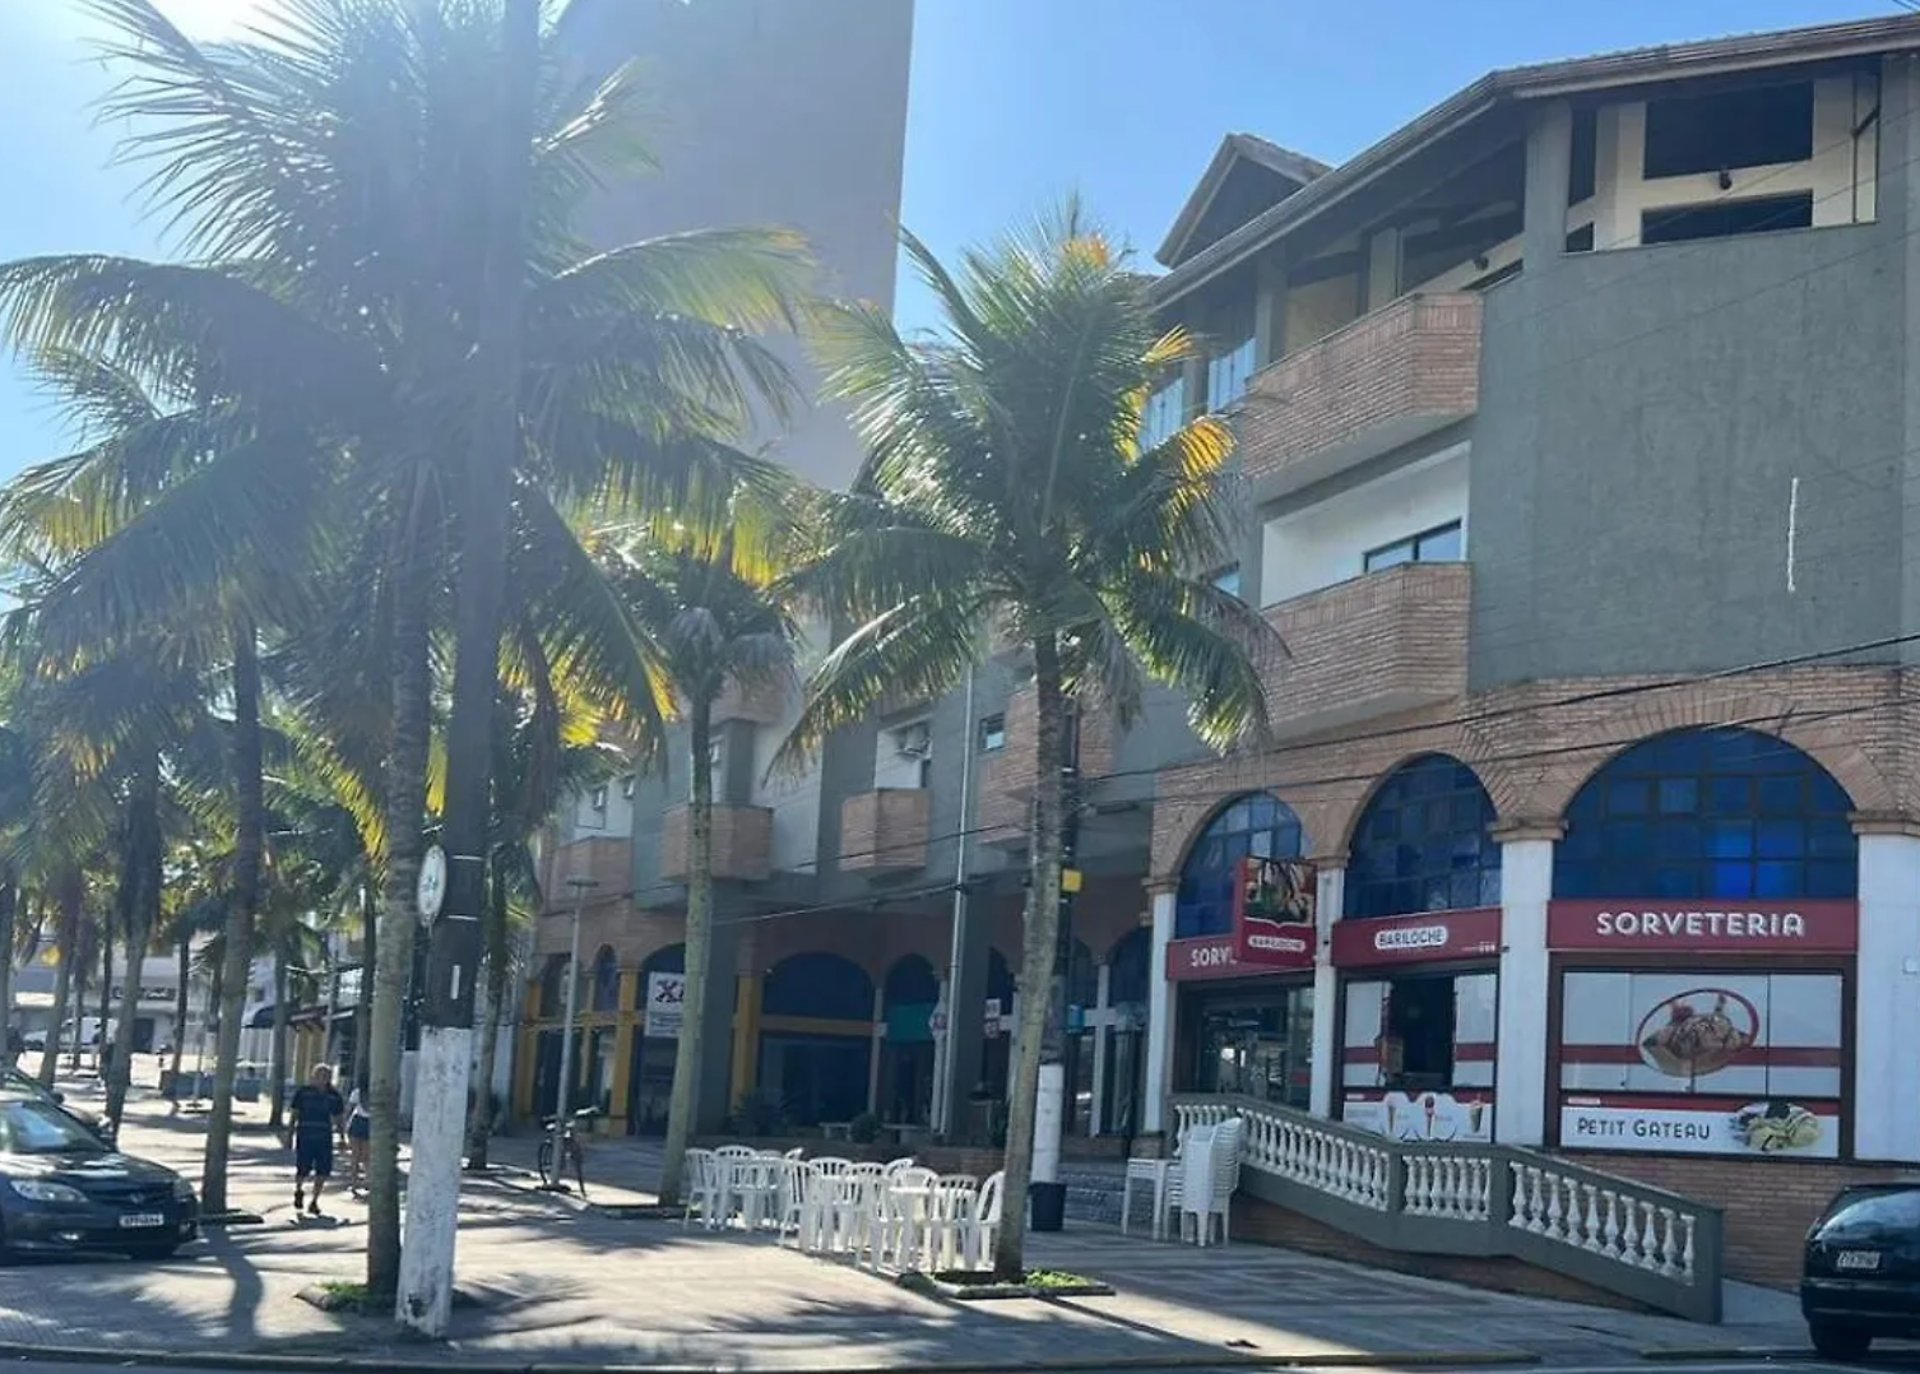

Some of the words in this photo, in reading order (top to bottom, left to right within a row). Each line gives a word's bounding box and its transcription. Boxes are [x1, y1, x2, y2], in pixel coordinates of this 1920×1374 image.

[1596, 912, 1805, 937] SORVETERIA
[1377, 927, 1446, 949] BARILOCHE
[1577, 1116, 1625, 1137] PETIT
[1634, 1119, 1711, 1141] GATEAU
